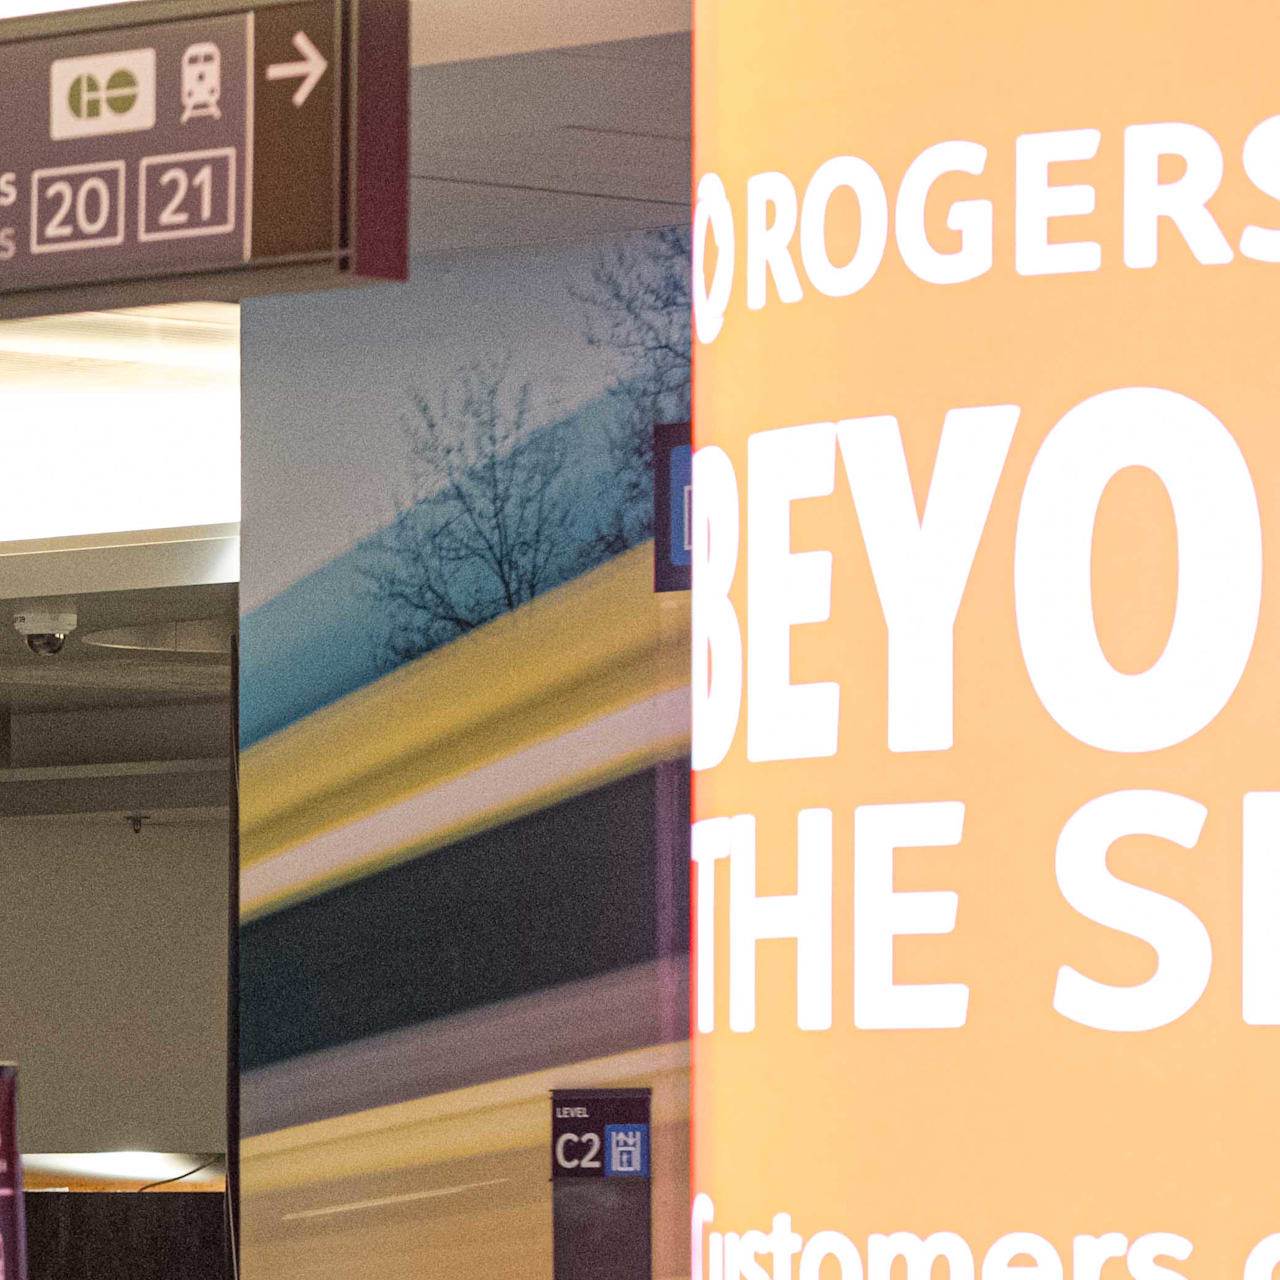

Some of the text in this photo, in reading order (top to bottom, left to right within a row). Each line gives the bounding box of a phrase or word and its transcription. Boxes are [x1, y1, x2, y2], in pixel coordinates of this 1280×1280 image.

[44, 165, 214, 239] 20 21
[691, 801, 969, 1033] THE
[556, 1106, 589, 1118] LEVEL
[556, 1132, 601, 1169] C2
